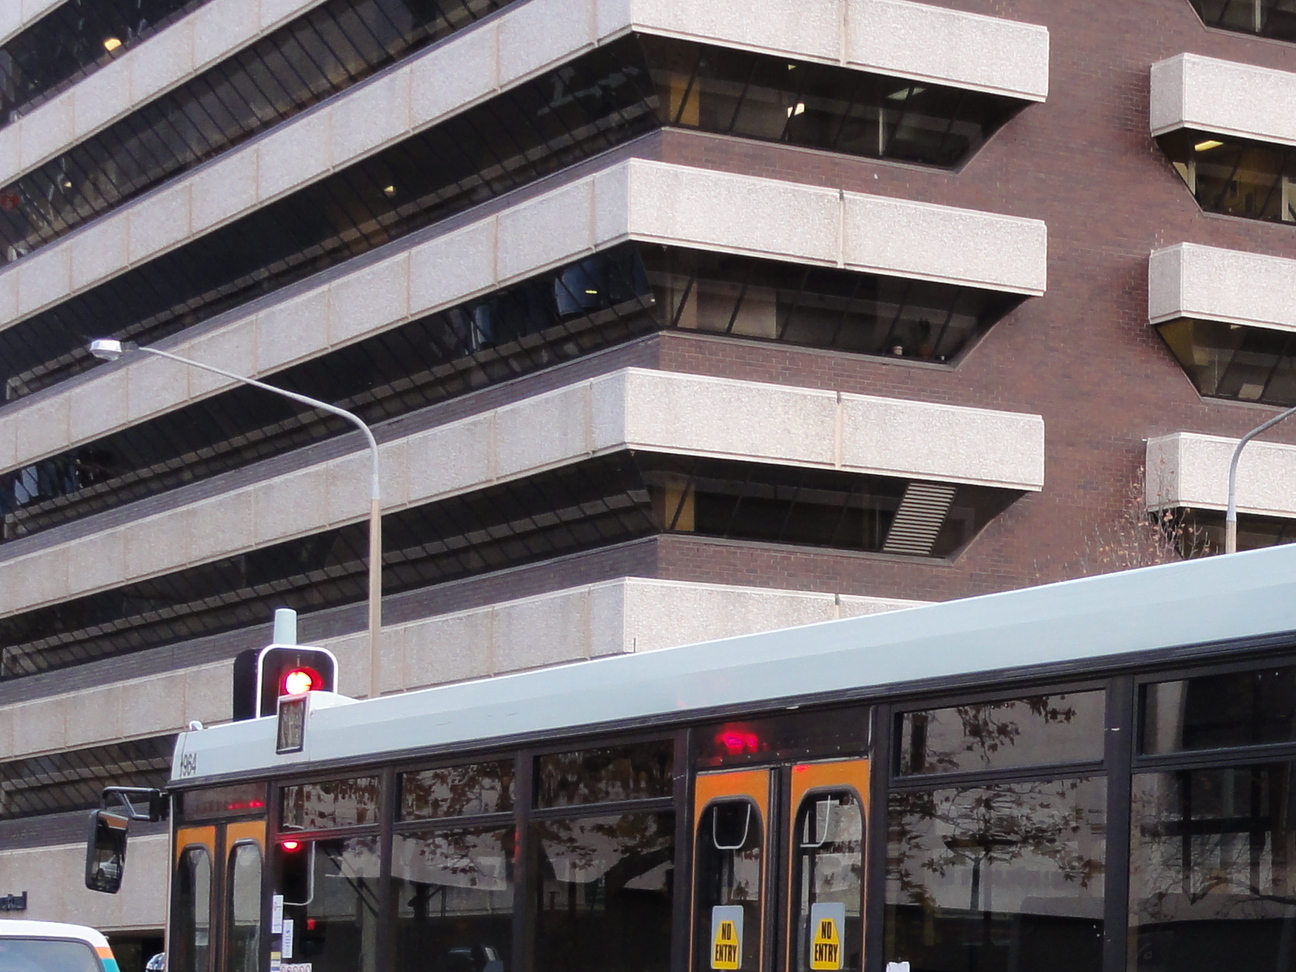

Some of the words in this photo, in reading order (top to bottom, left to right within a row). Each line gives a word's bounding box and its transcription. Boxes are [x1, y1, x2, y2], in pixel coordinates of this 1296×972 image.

[721, 923, 732, 941] NO
[820, 921, 832, 940] NO
[715, 943, 738, 963] ENTRY
[814, 943, 839, 963] ENTRY
